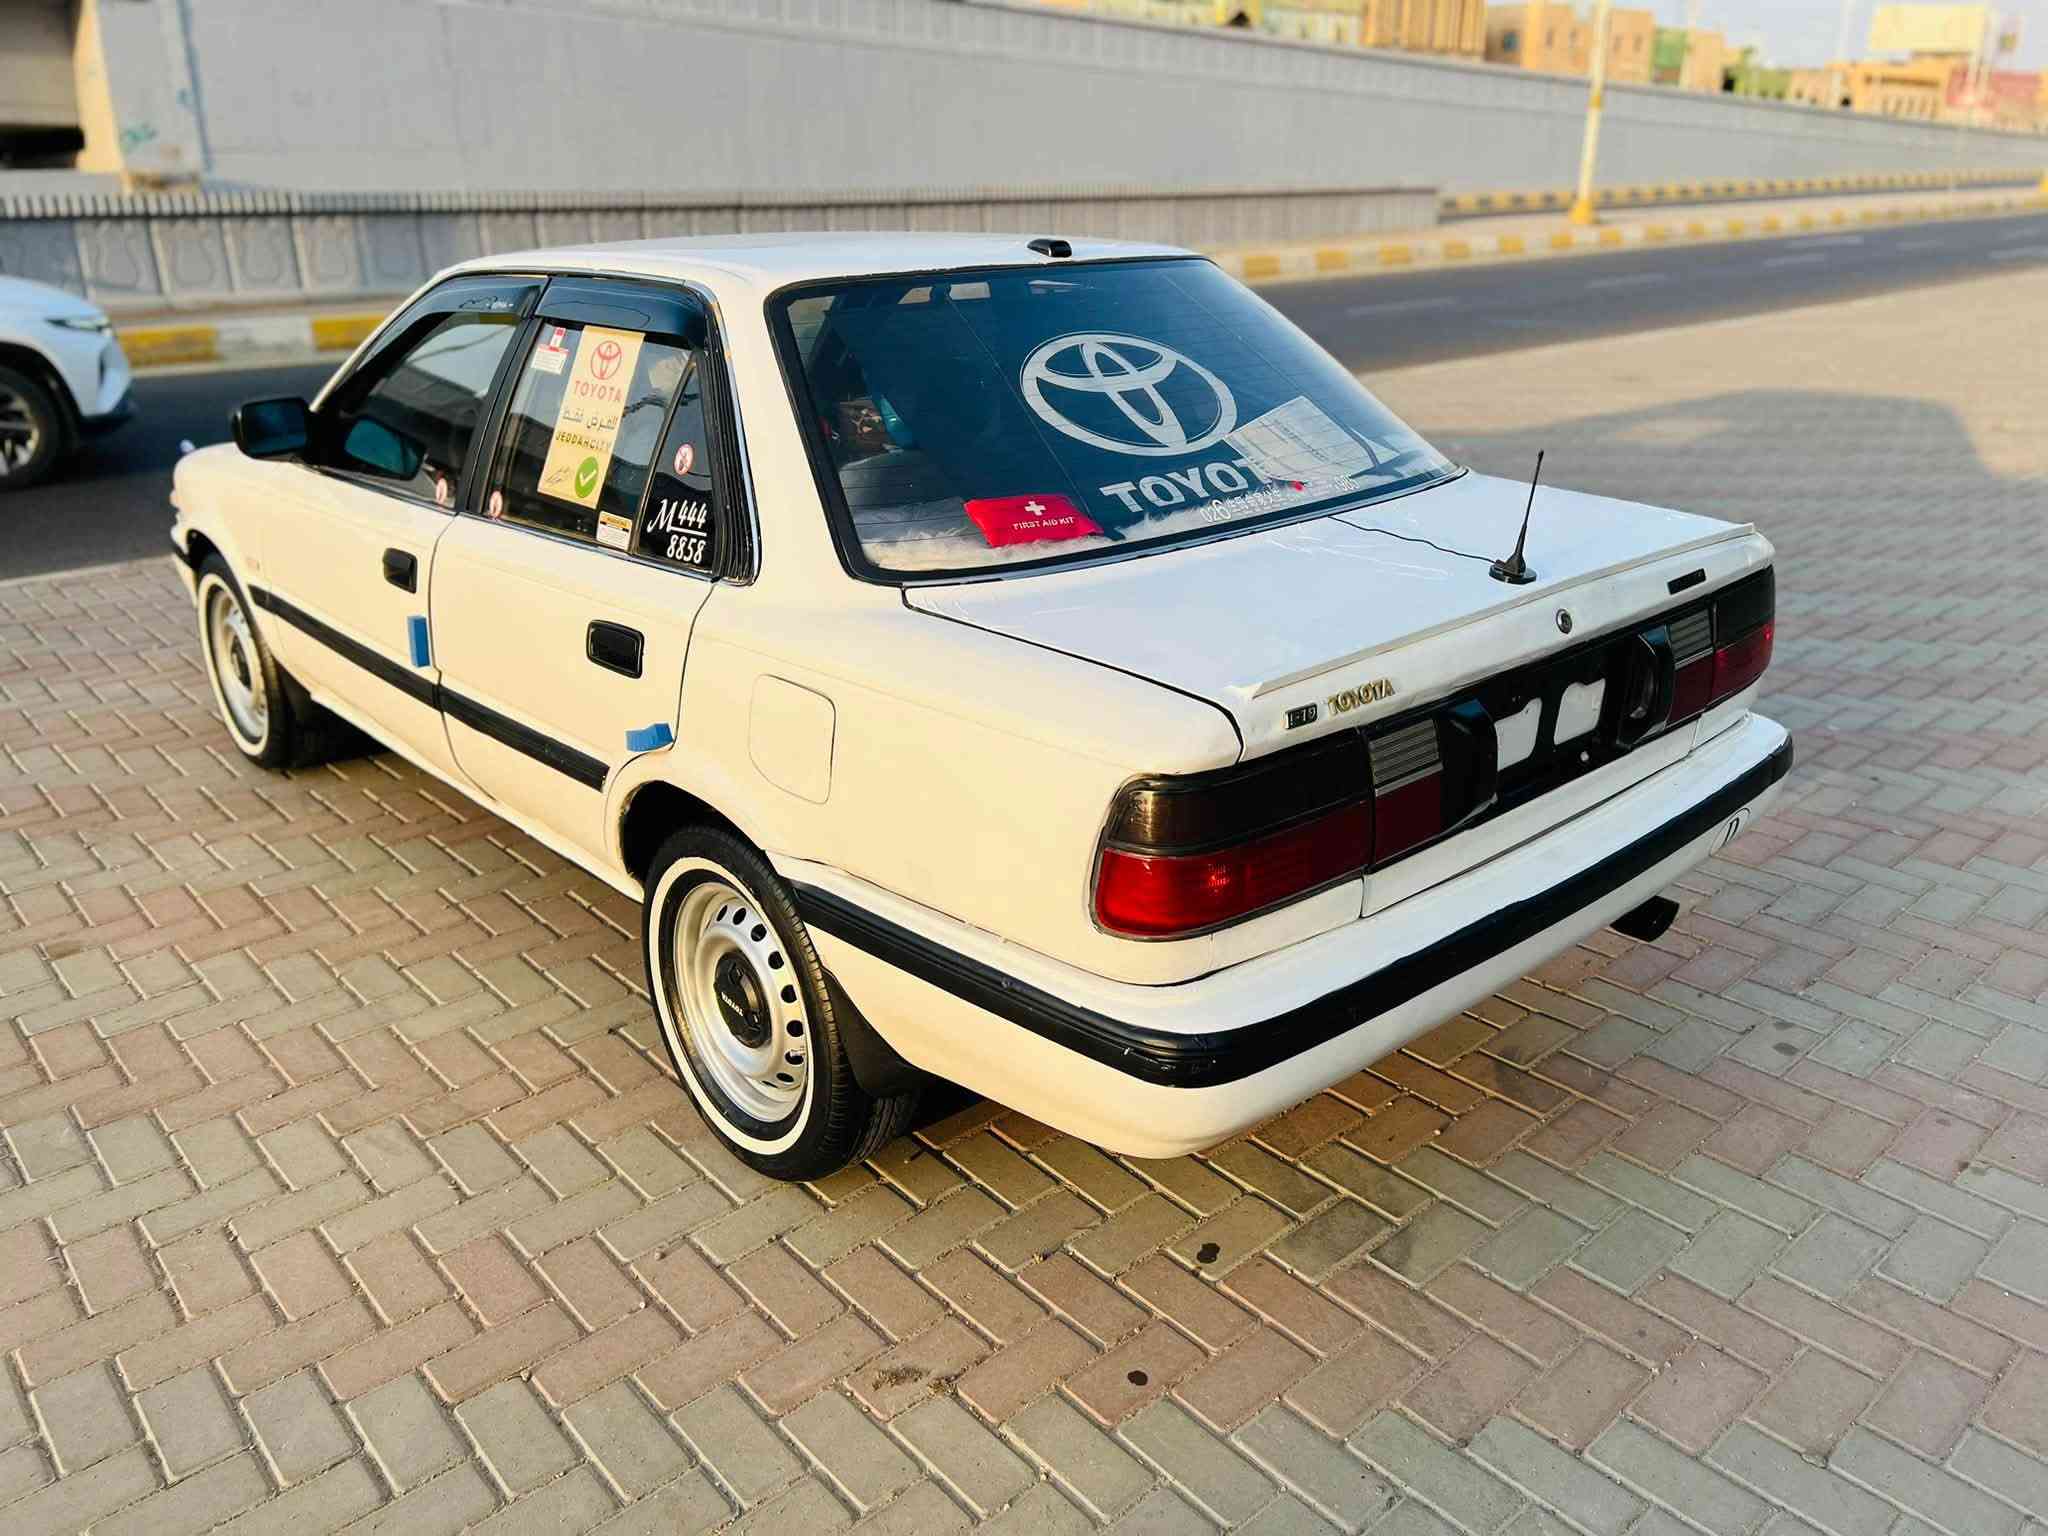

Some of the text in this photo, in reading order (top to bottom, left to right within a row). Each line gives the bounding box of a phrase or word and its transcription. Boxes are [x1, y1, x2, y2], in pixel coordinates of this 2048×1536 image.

[575, 380, 623, 402] TOYOTA
[646, 498, 678, 533] M
[678, 499, 707, 529] 444
[1012, 515, 1075, 531] FIRST AID KIT
[666, 534, 707, 564] 8858
[1327, 677, 1395, 716] TOYOTA
